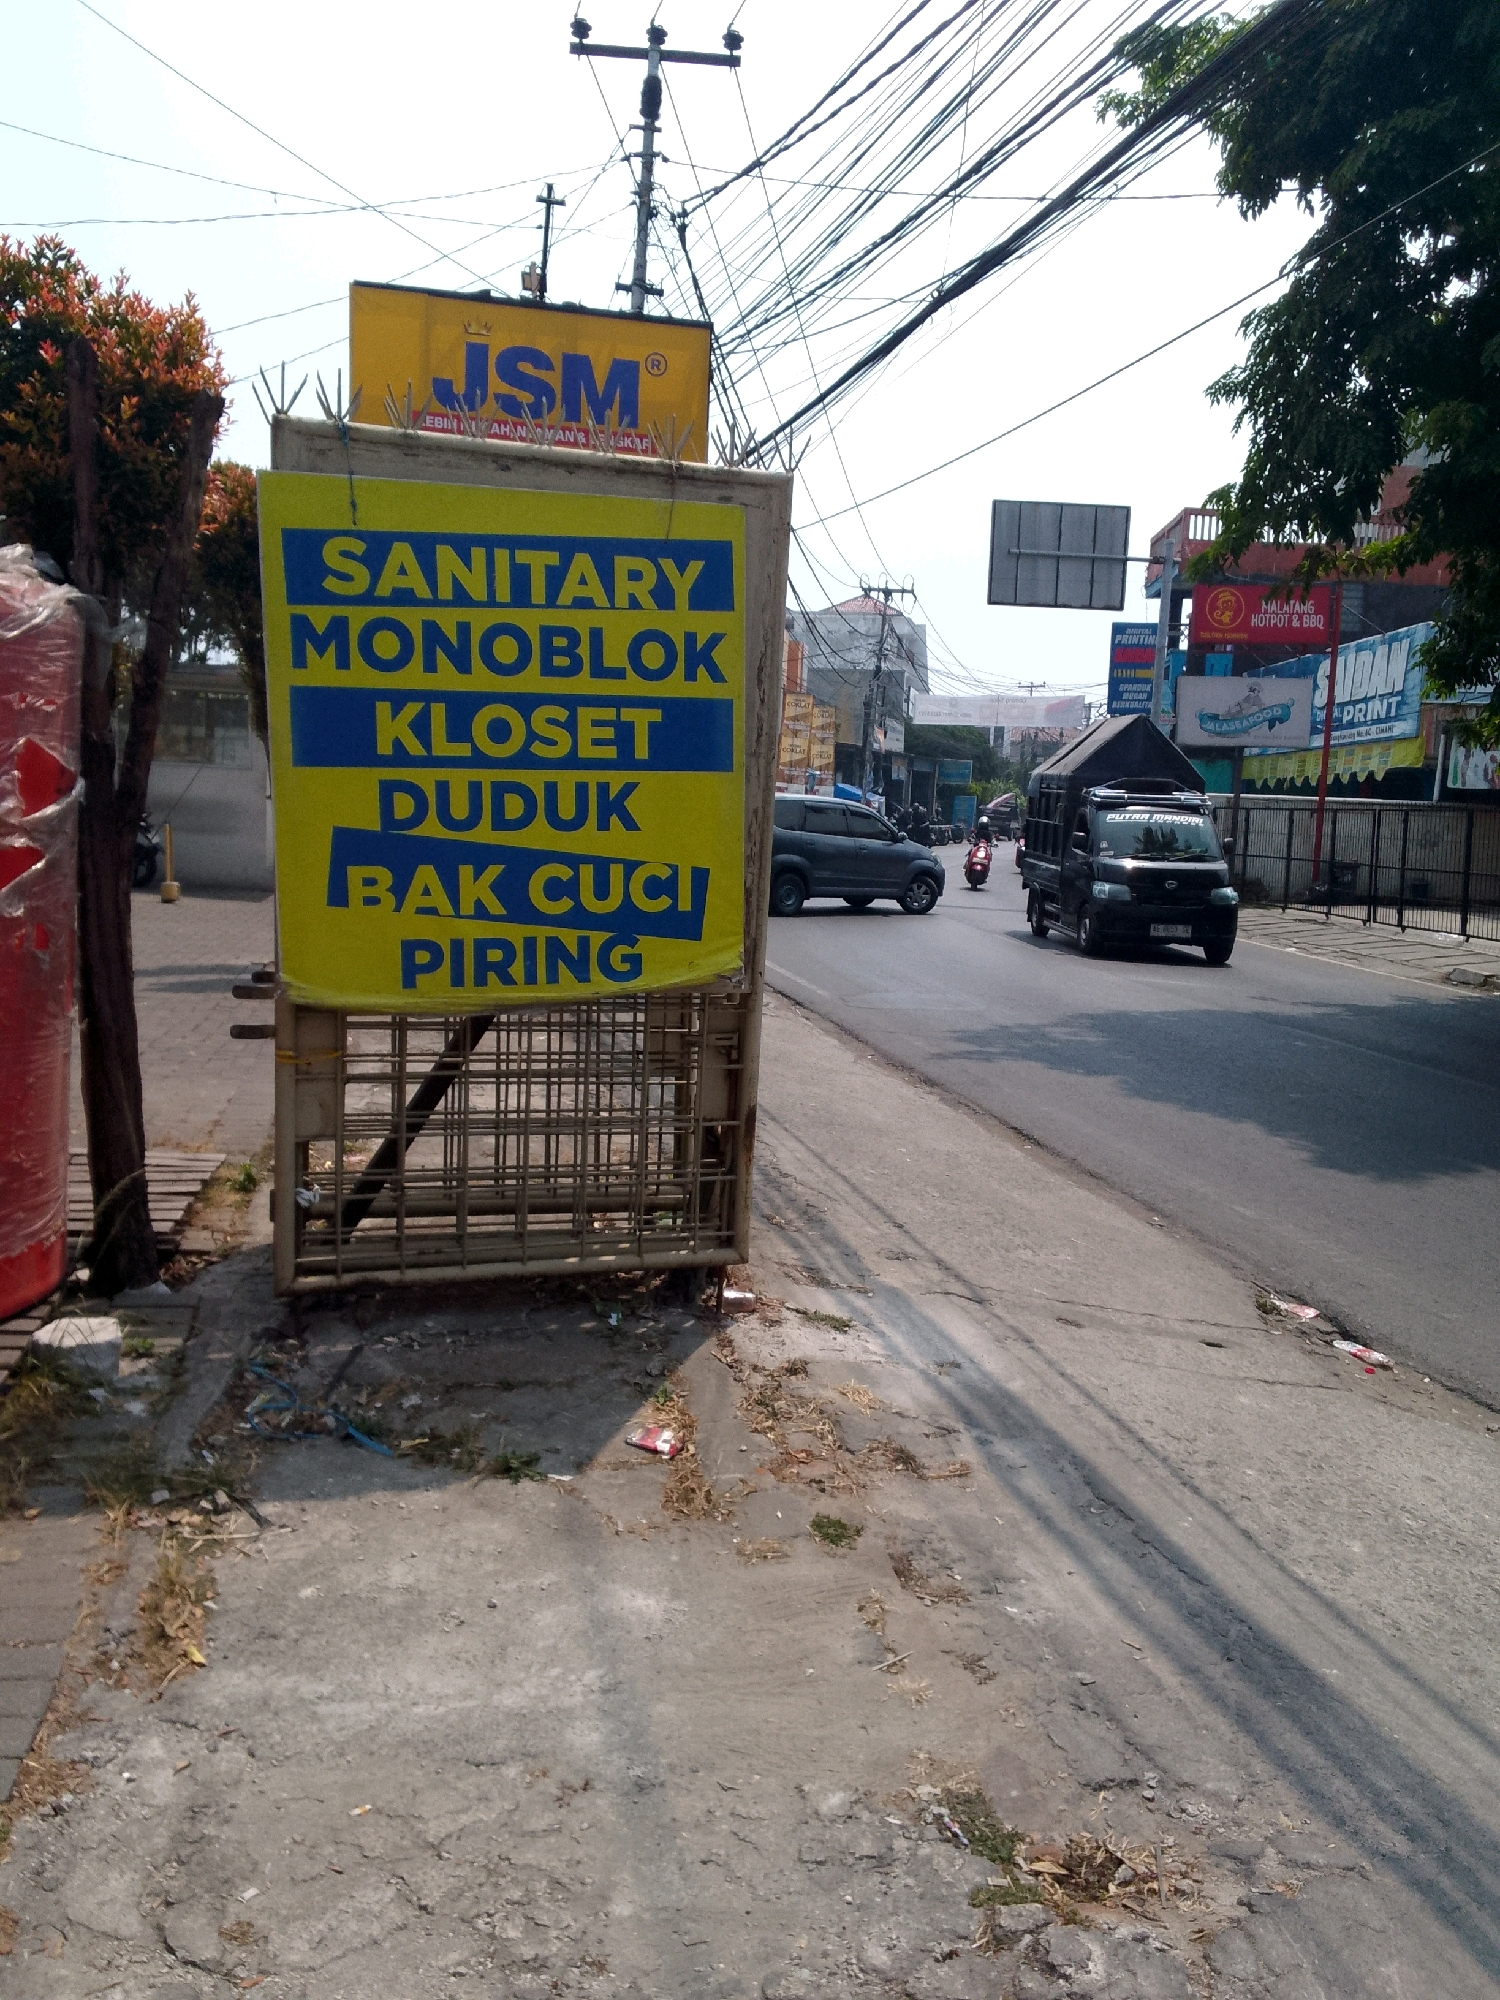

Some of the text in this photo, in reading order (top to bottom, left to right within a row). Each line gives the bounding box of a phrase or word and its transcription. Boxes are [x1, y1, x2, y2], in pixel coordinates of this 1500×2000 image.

[432, 341, 640, 429] JSM
[420, 415, 458, 431] EBIH
[322, 536, 705, 610] SANITARY
[1261, 599, 1314, 614] MALATANG
[1251, 614, 1325, 630] HOTPOT & BBQ
[289, 612, 729, 684] MONOBLOK
[1114, 634, 1158, 645] PRINTIN
[786, 701, 811, 709] COKLAT
[1342, 695, 1402, 725] PRINT
[375, 701, 662, 760] KLOSET
[781, 747, 806, 755] COKLAT
[378, 779, 642, 832] DUDUK
[1106, 813, 1204, 824] PUTRA MANDIRI
[347, 862, 693, 916] BAK CUCI
[400, 933, 643, 990] PIRING
